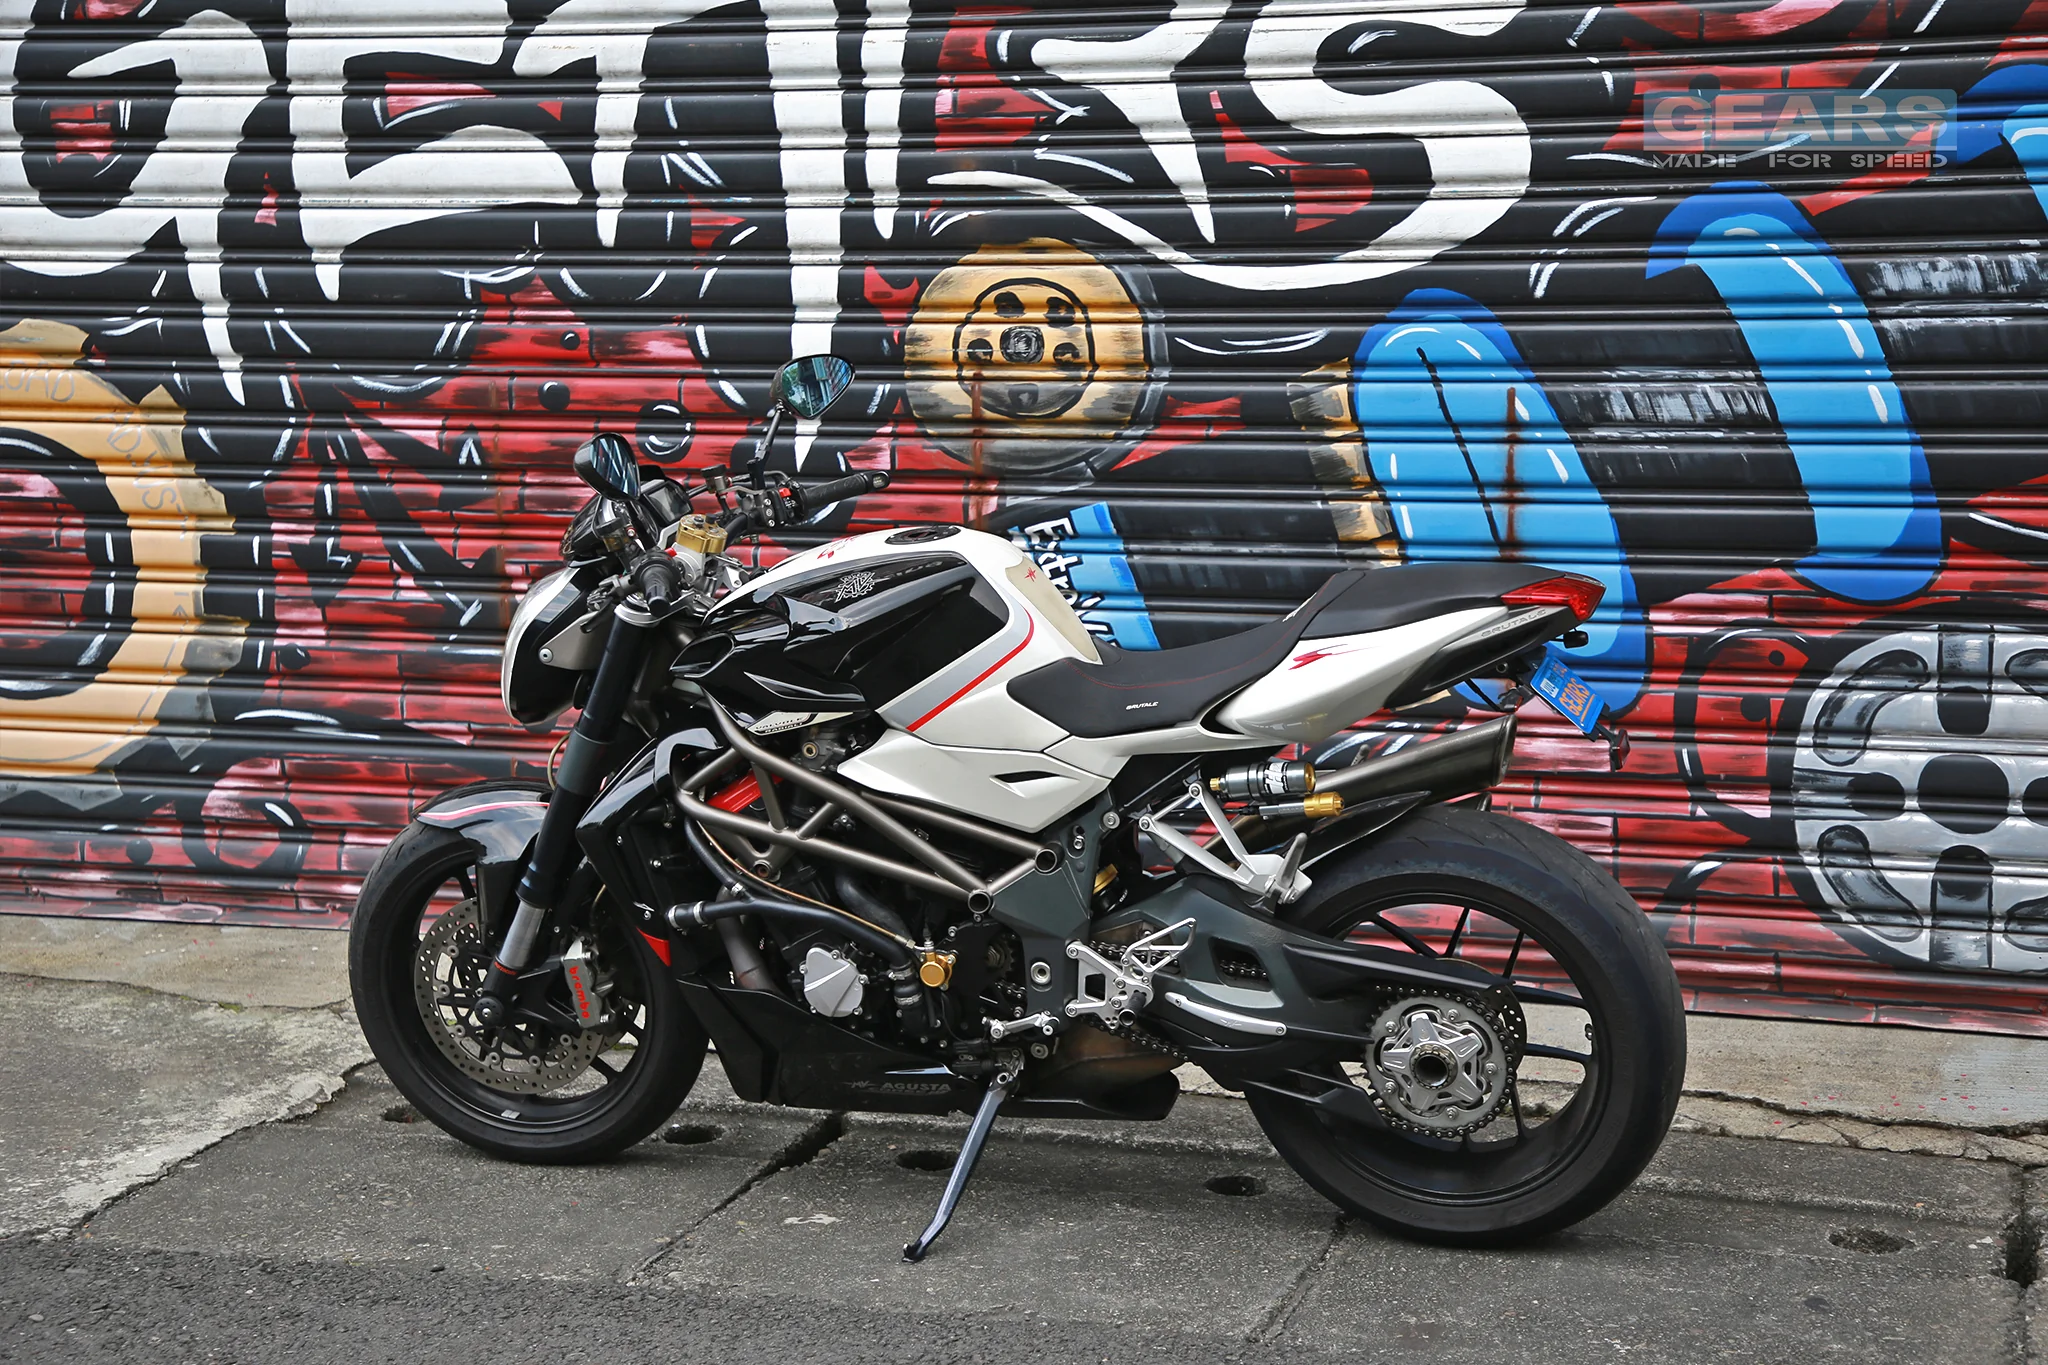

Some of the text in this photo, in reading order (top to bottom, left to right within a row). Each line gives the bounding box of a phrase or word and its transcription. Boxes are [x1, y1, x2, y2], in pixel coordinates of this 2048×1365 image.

[1481, 608, 1547, 638] BRUTALE
[1125, 701, 1159, 710] BRUTALE
[1559, 678, 1589, 716] GEARS
[569, 966, 590, 1019] brembo
[881, 1082, 951, 1091] AGUSTA
